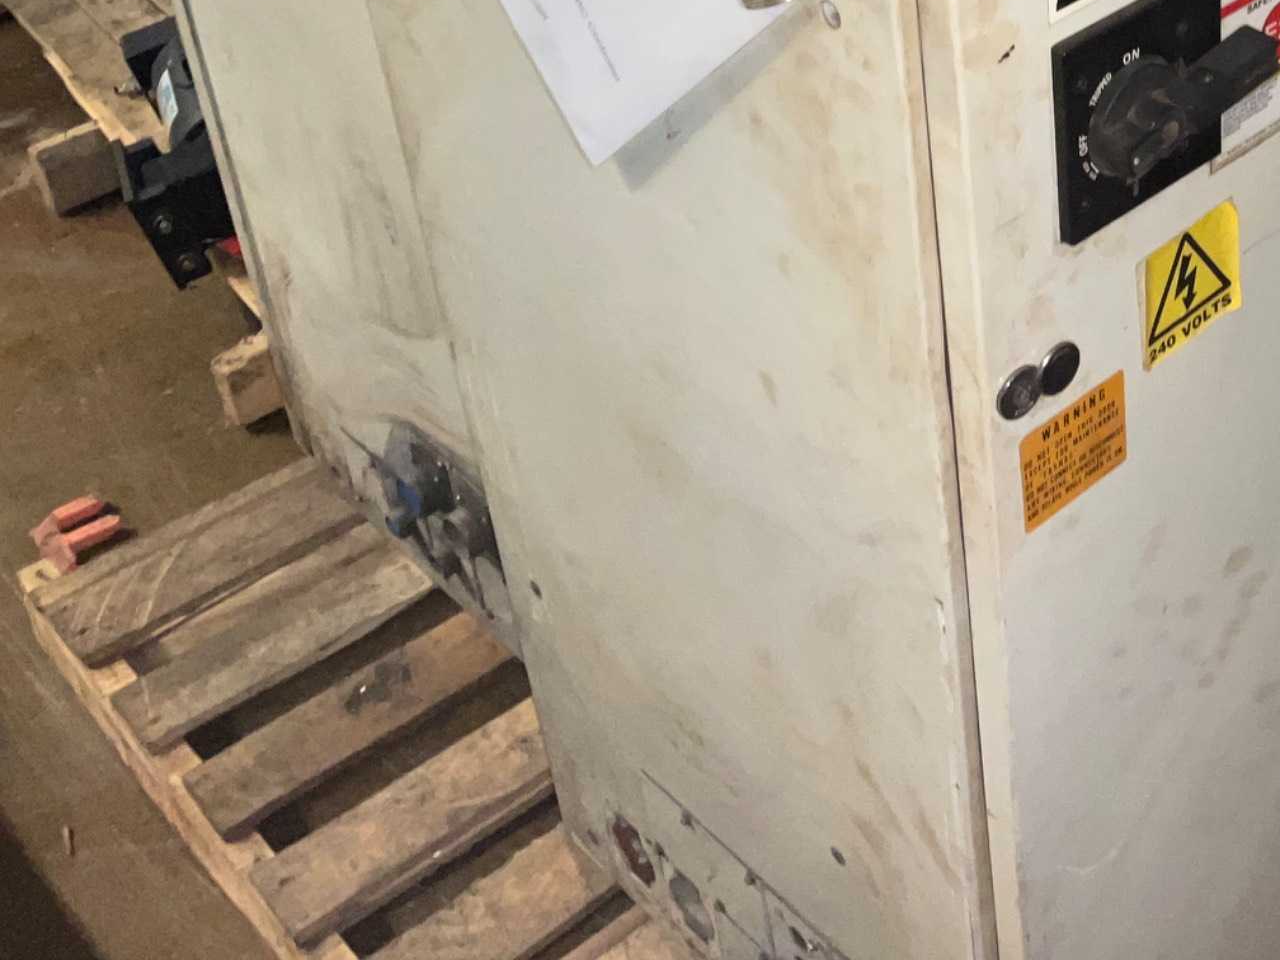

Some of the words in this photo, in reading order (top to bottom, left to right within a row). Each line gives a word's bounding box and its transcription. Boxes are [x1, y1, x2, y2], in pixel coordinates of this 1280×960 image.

[1123, 48, 1140, 65] ON
[1150, 334, 1176, 363] 240
[1182, 294, 1232, 337] VOLTS
[1042, 389, 1105, 440] WARNING
